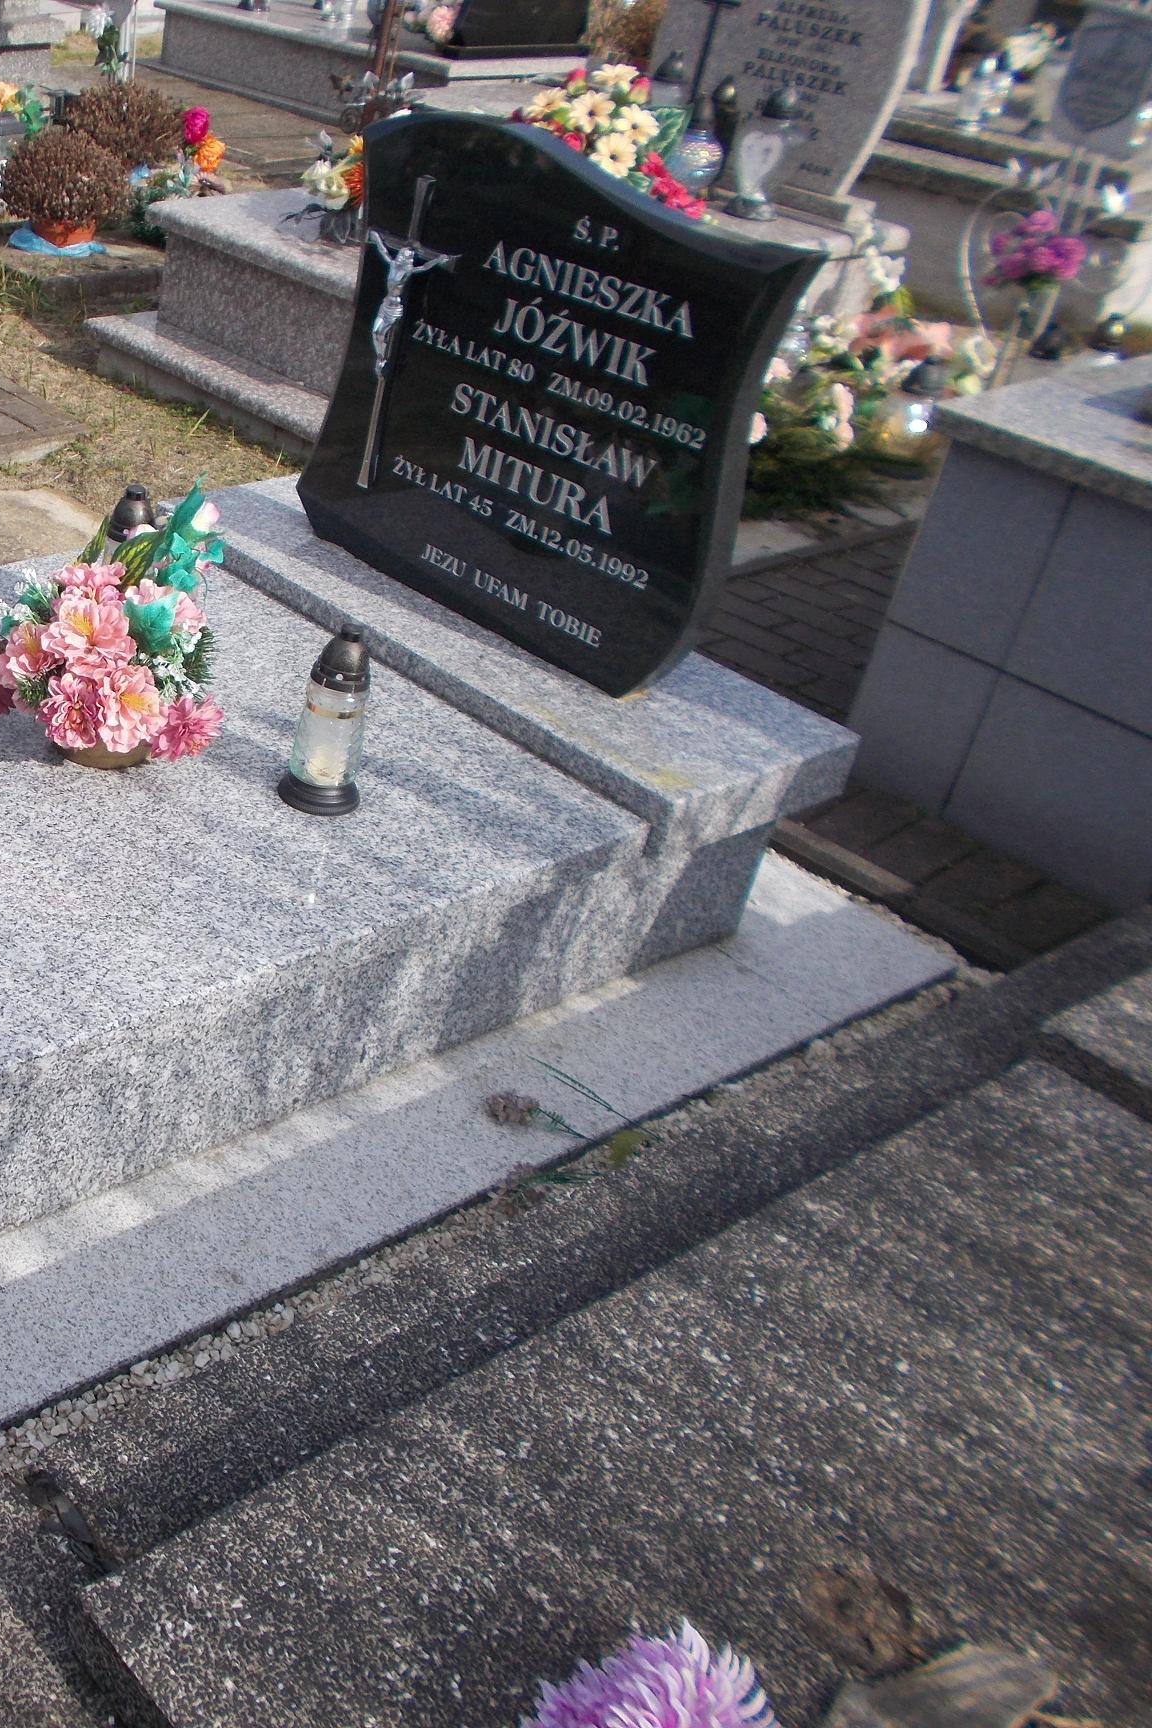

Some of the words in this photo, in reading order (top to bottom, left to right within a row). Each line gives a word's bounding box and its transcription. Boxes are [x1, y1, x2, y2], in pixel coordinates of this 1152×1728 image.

[756, 12, 864, 47] PALUSZEK
[600, 226, 620, 251] P.
[483, 240, 695, 339] AGNIESZKA
[412, 318, 461, 356] ŻYŁA
[465, 341, 507, 372] LAT
[507, 358, 536, 383] 80
[494, 297, 656, 387] JÓŹWIK
[450, 382, 659, 489] STANISŁAW
[392, 454, 426, 486] ŻYŁ
[429, 473, 467, 504] LAT
[468, 495, 495, 517] 45
[458, 436, 614, 536] MITURA
[421, 543, 467, 578] JEZU
[473, 568, 530, 611] UFAM
[536, 600, 603, 649] TOBIE
